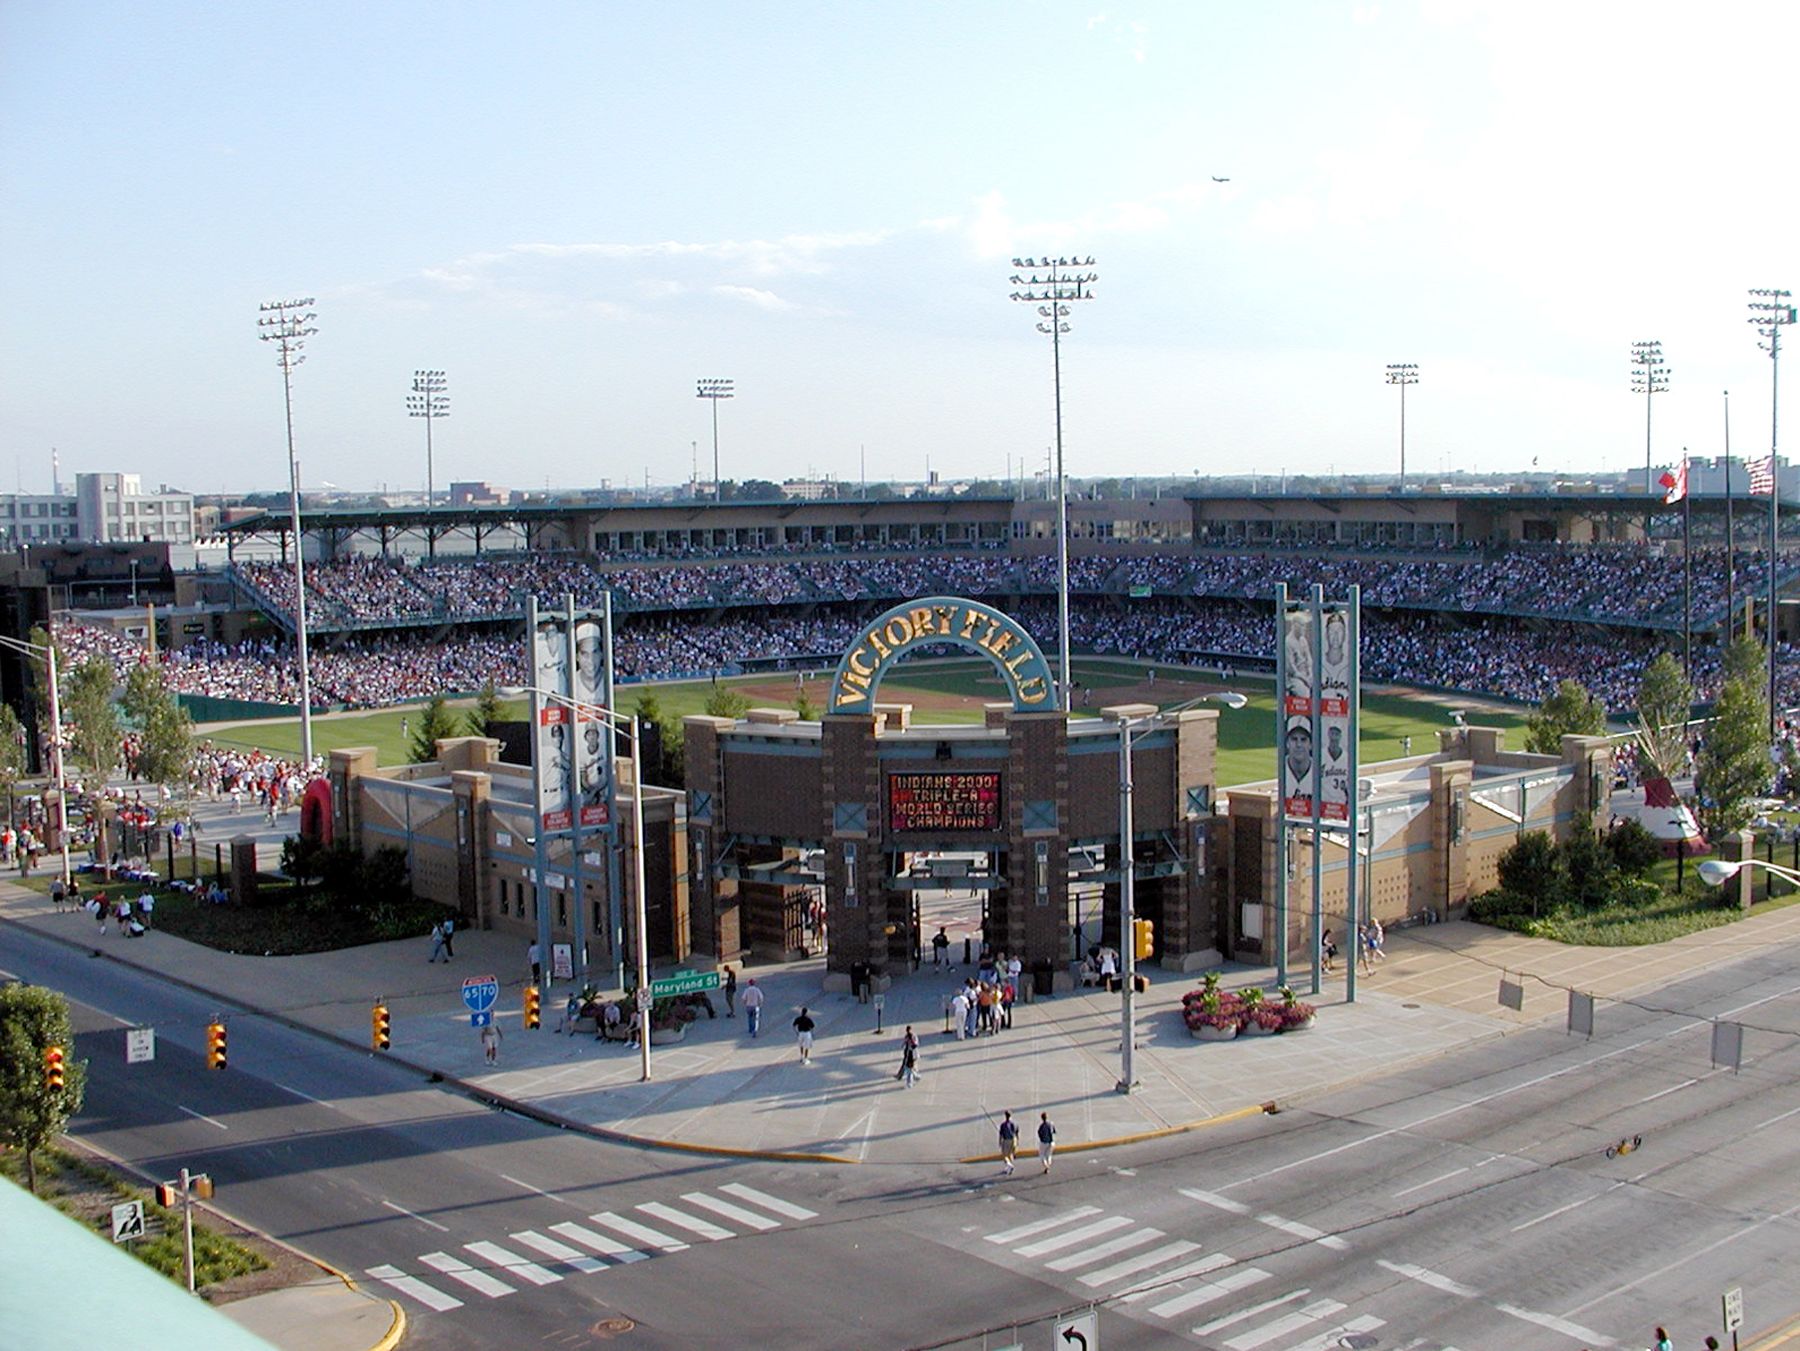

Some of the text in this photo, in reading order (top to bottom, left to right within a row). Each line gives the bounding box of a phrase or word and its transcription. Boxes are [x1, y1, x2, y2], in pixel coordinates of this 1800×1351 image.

[836, 605, 1047, 707] VICTORY FIELD
[897, 775, 992, 789] INDIANS 2000
[913, 789, 978, 802] TRIPLE-A
[896, 802, 994, 815] WORLD SERIES
[907, 815, 985, 828] CHAMPIONS
[654, 975, 718, 994] Maryland St
[464, 985, 495, 999] 65 70
